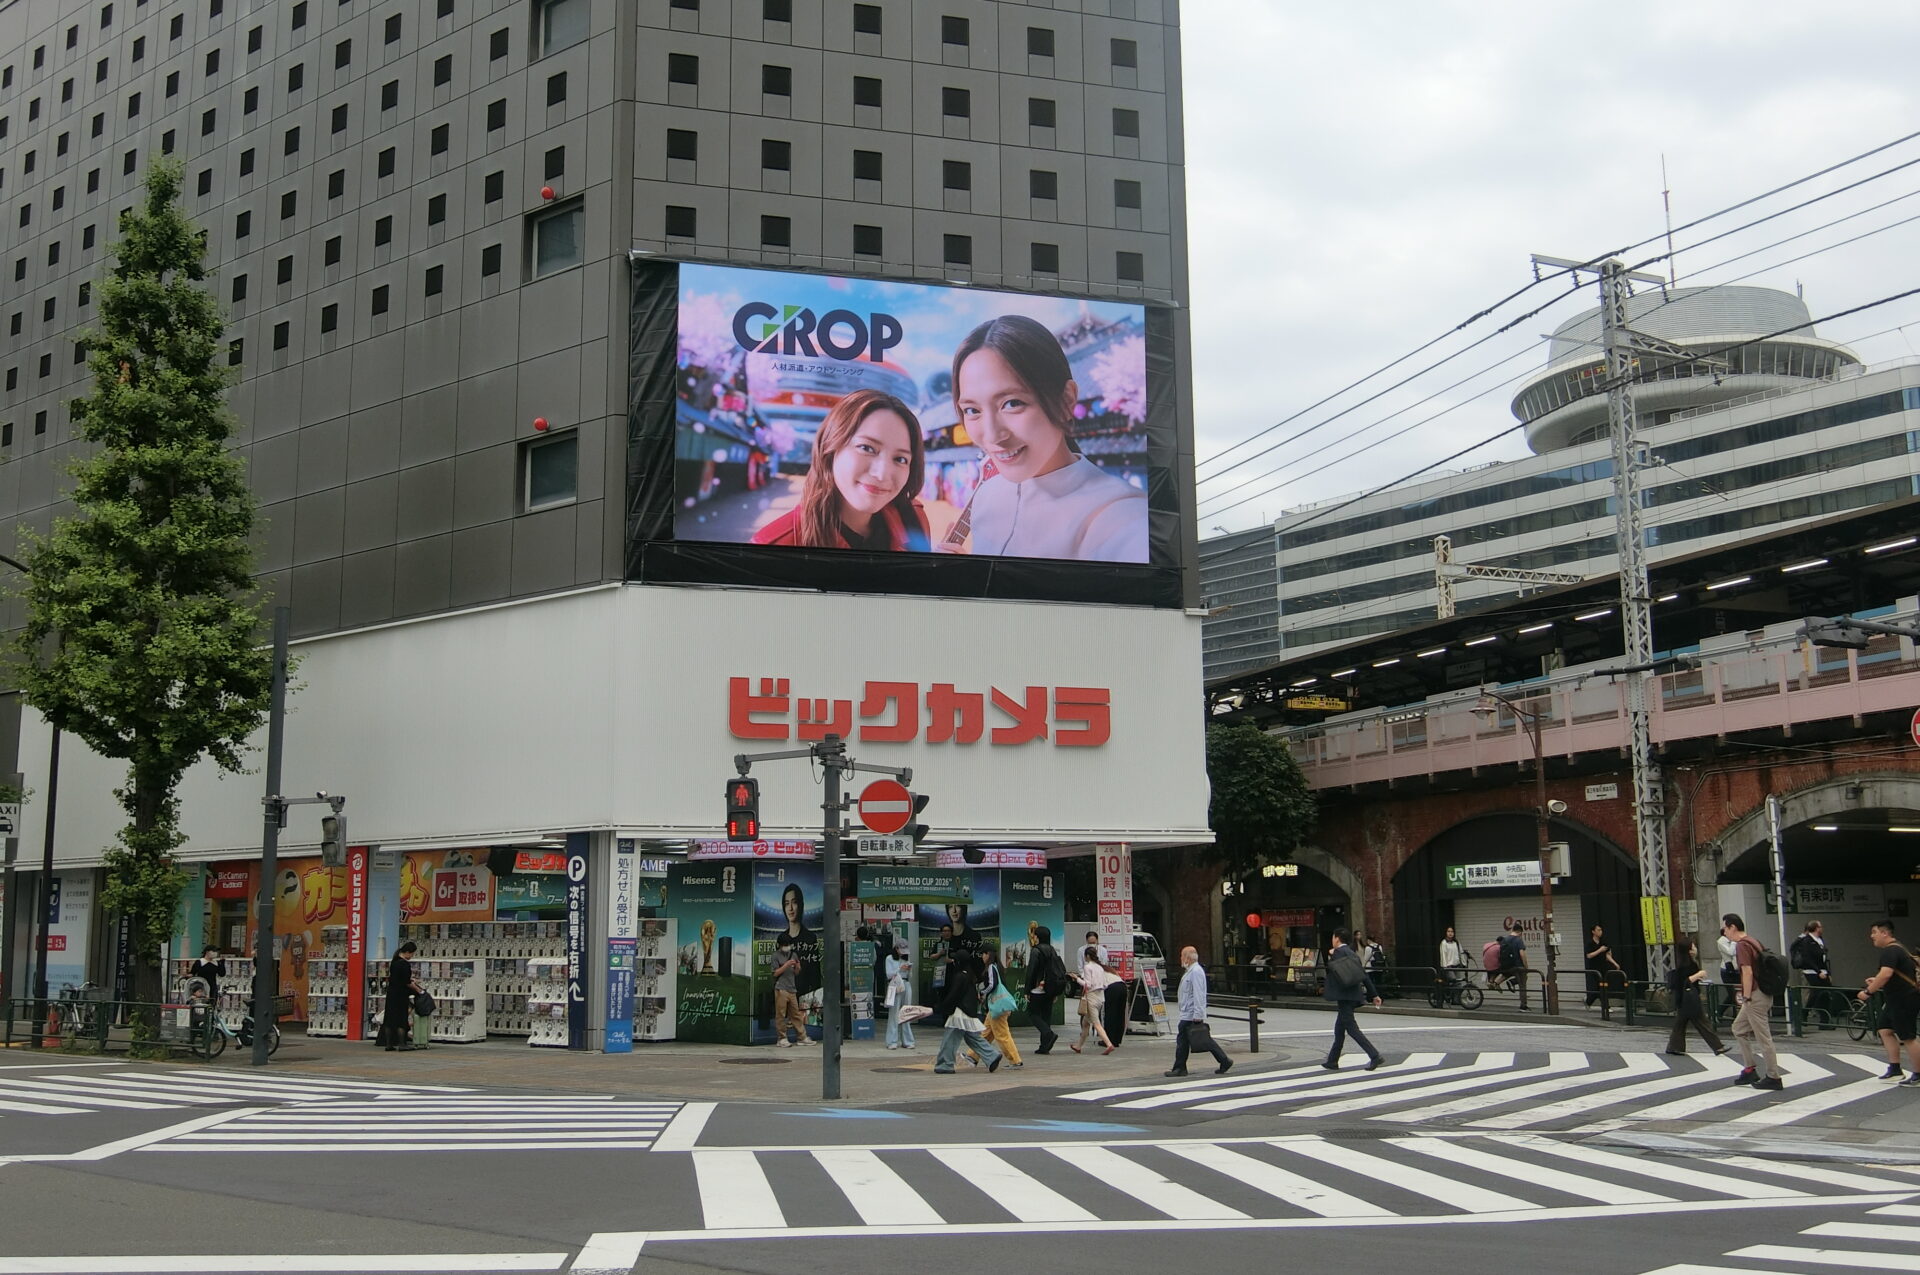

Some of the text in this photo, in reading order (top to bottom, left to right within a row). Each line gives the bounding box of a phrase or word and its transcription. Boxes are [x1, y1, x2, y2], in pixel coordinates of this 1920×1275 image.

[732, 301, 904, 363] GROP
[729, 677, 1111, 746] ビックカメラ
[697, 842, 744, 854] 0:00PM
[860, 839, 911, 852] 自転車を除く
[1099, 855, 1121, 874] 10
[1448, 867, 1465, 881] JR
[1467, 866, 1498, 878] 有楽町駅
[459, 873, 477, 887] でも
[683, 876, 716, 885] Hisense
[882, 876, 897, 886] FIFA
[898, 877, 920, 886] WORLD
[921, 878, 934, 887] CUP
[1012, 882, 1040, 891] Hisense
[1103, 876, 1116, 890] 時
[438, 881, 455, 899] 6F
[616, 857, 630, 926] 処方せん受付
[1800, 887, 1845, 902] 有楽町駅
[458, 891, 487, 905] 取扱中
[351, 873, 362, 954] ビックカメラ
[569, 885, 580, 979] 次の信号を右折
[616, 927, 631, 937] 3F
[715, 996, 737, 1022] Life
